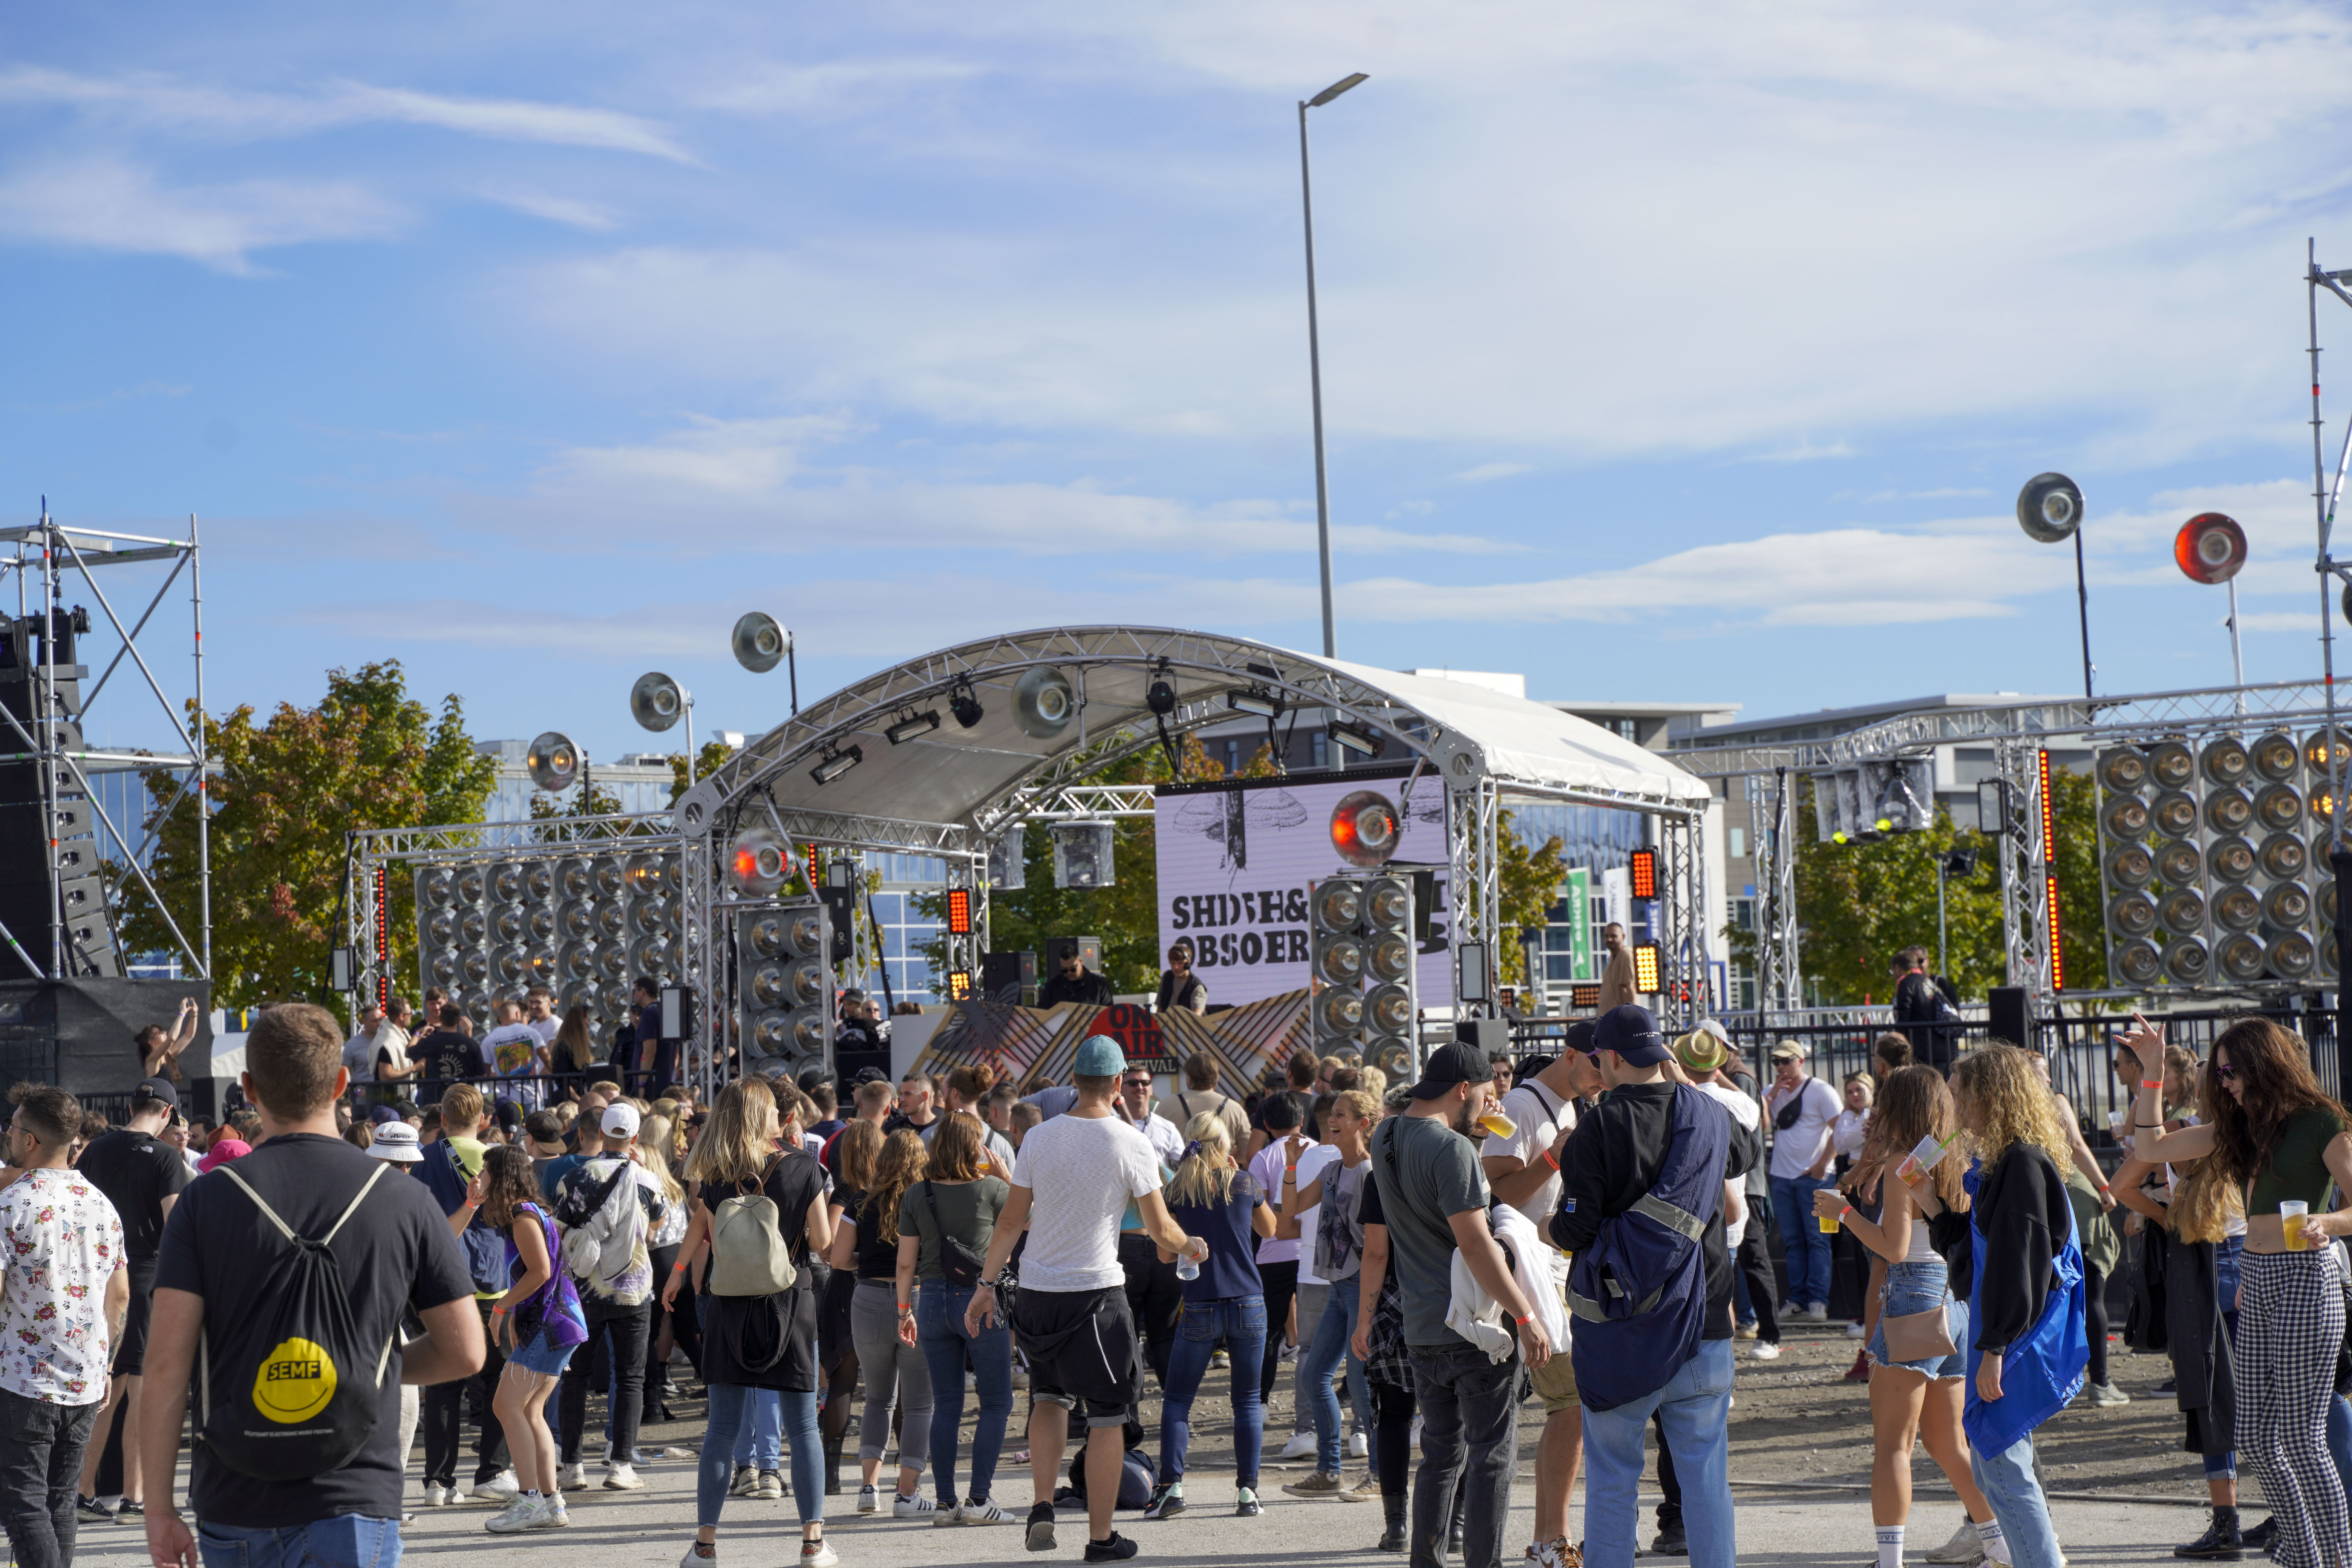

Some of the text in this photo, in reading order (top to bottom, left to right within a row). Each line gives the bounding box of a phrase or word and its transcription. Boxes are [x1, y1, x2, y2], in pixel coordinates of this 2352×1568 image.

[1109, 1004, 1152, 1029] ON
[1113, 1030, 1164, 1055] AIR
[268, 1362, 319, 1380] SEMF
